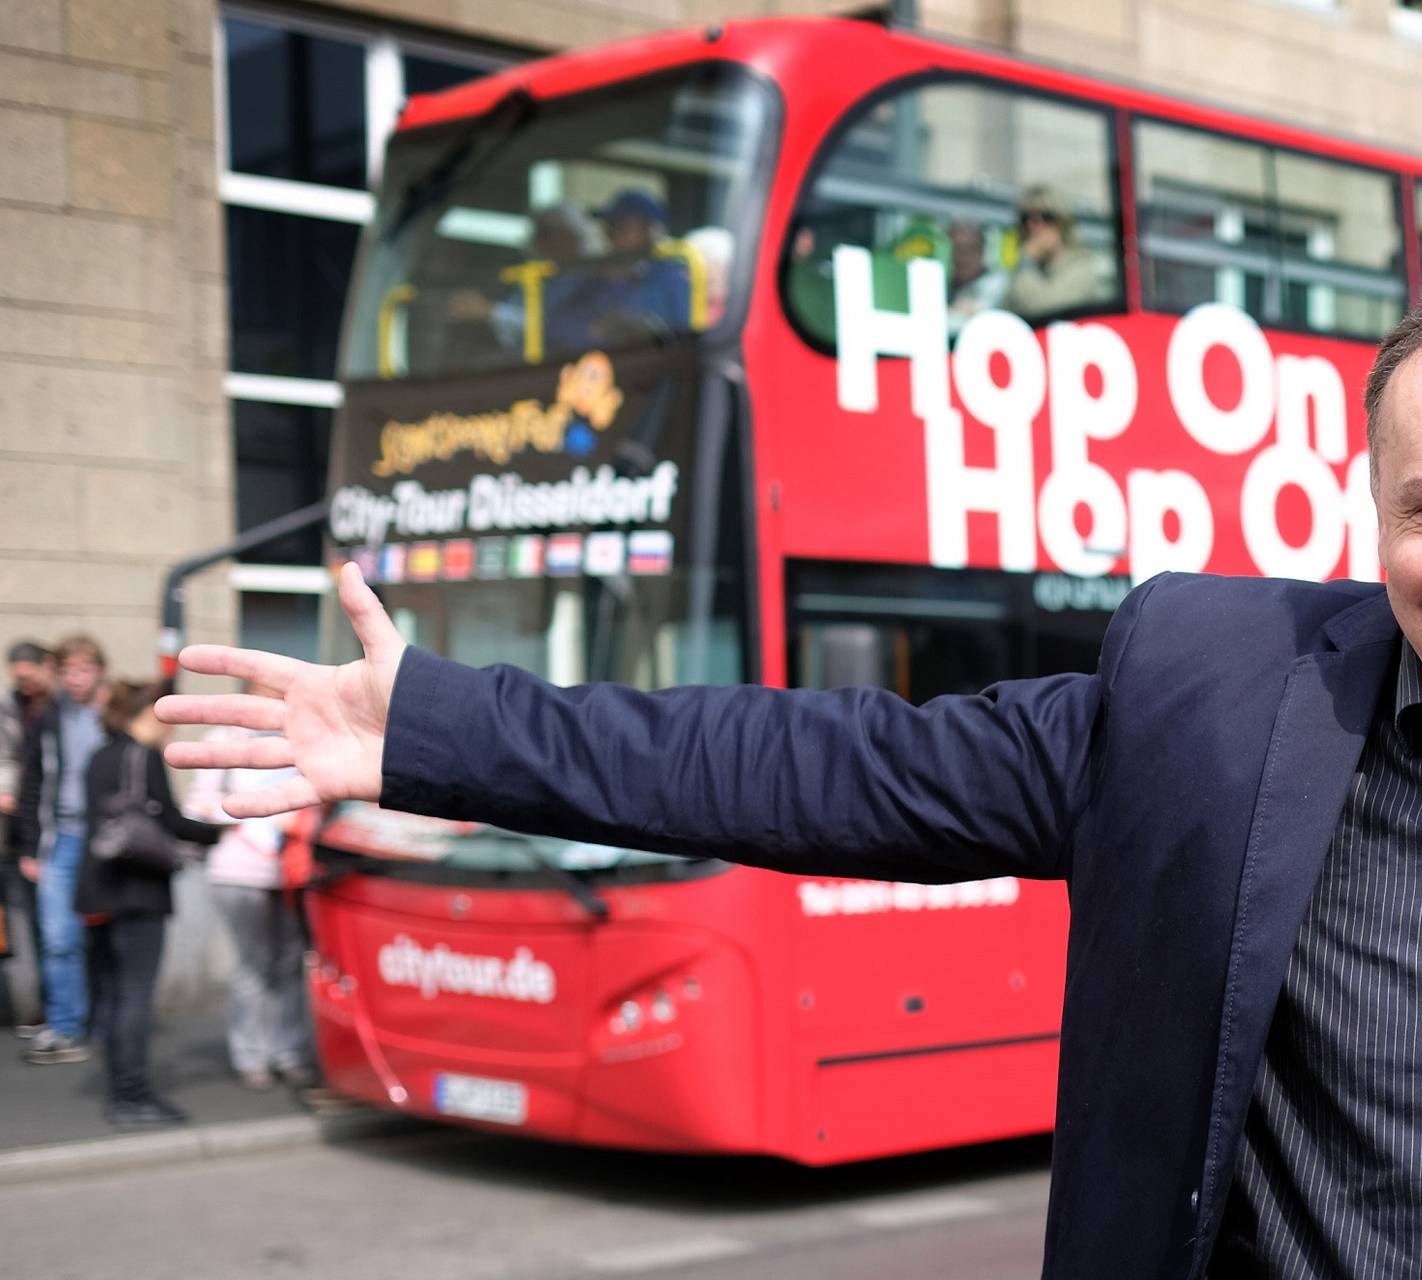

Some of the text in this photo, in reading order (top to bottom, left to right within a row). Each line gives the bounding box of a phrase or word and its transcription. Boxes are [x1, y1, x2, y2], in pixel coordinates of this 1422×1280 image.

[833, 243, 1348, 466] Hop On
[468, 460, 679, 532] Düsseldorf
[924, 405, 1386, 585] Hop Of
[378, 932, 556, 1004] citytour.de
